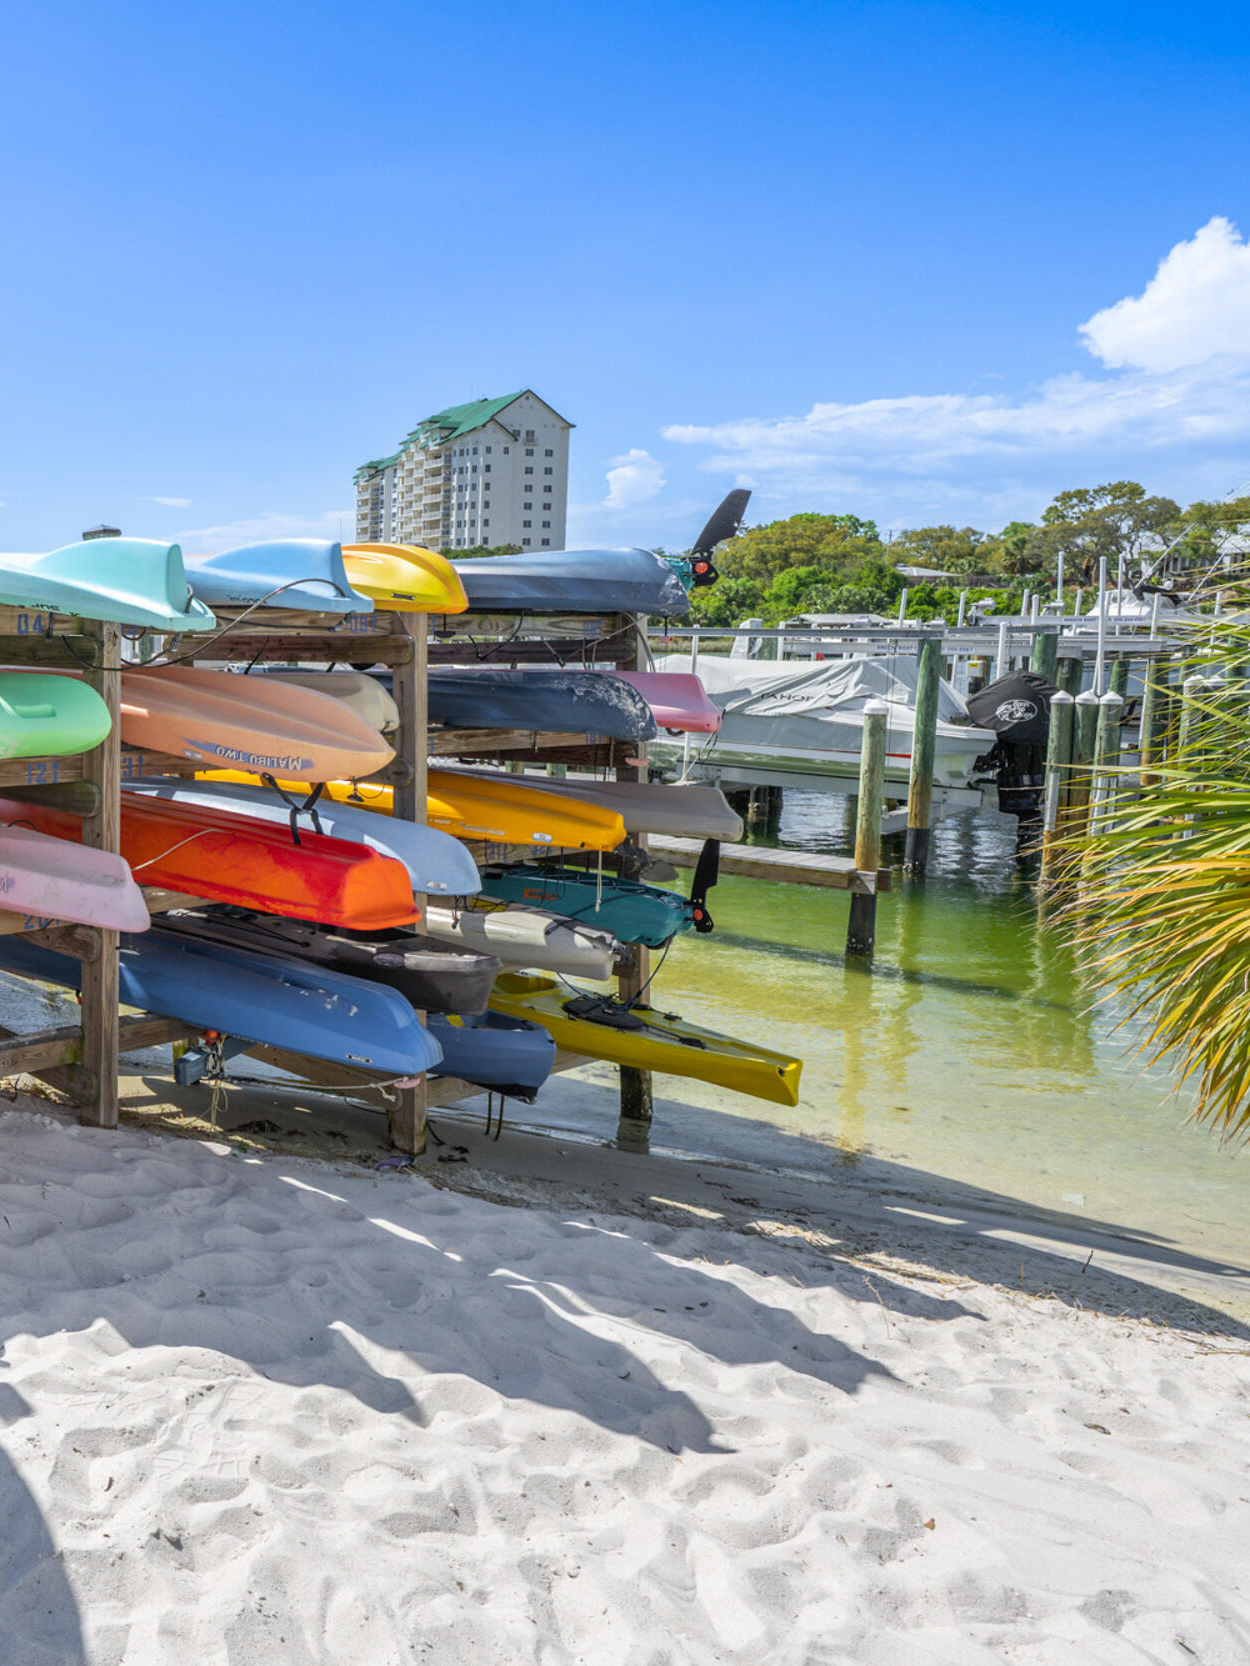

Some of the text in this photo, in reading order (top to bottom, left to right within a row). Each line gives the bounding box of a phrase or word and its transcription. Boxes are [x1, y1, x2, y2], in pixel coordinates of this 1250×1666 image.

[17, 613, 43, 635] 04
[215, 744, 246, 762] TWO
[249, 753, 303, 771] MALIBU
[27, 762, 48, 785] 12
